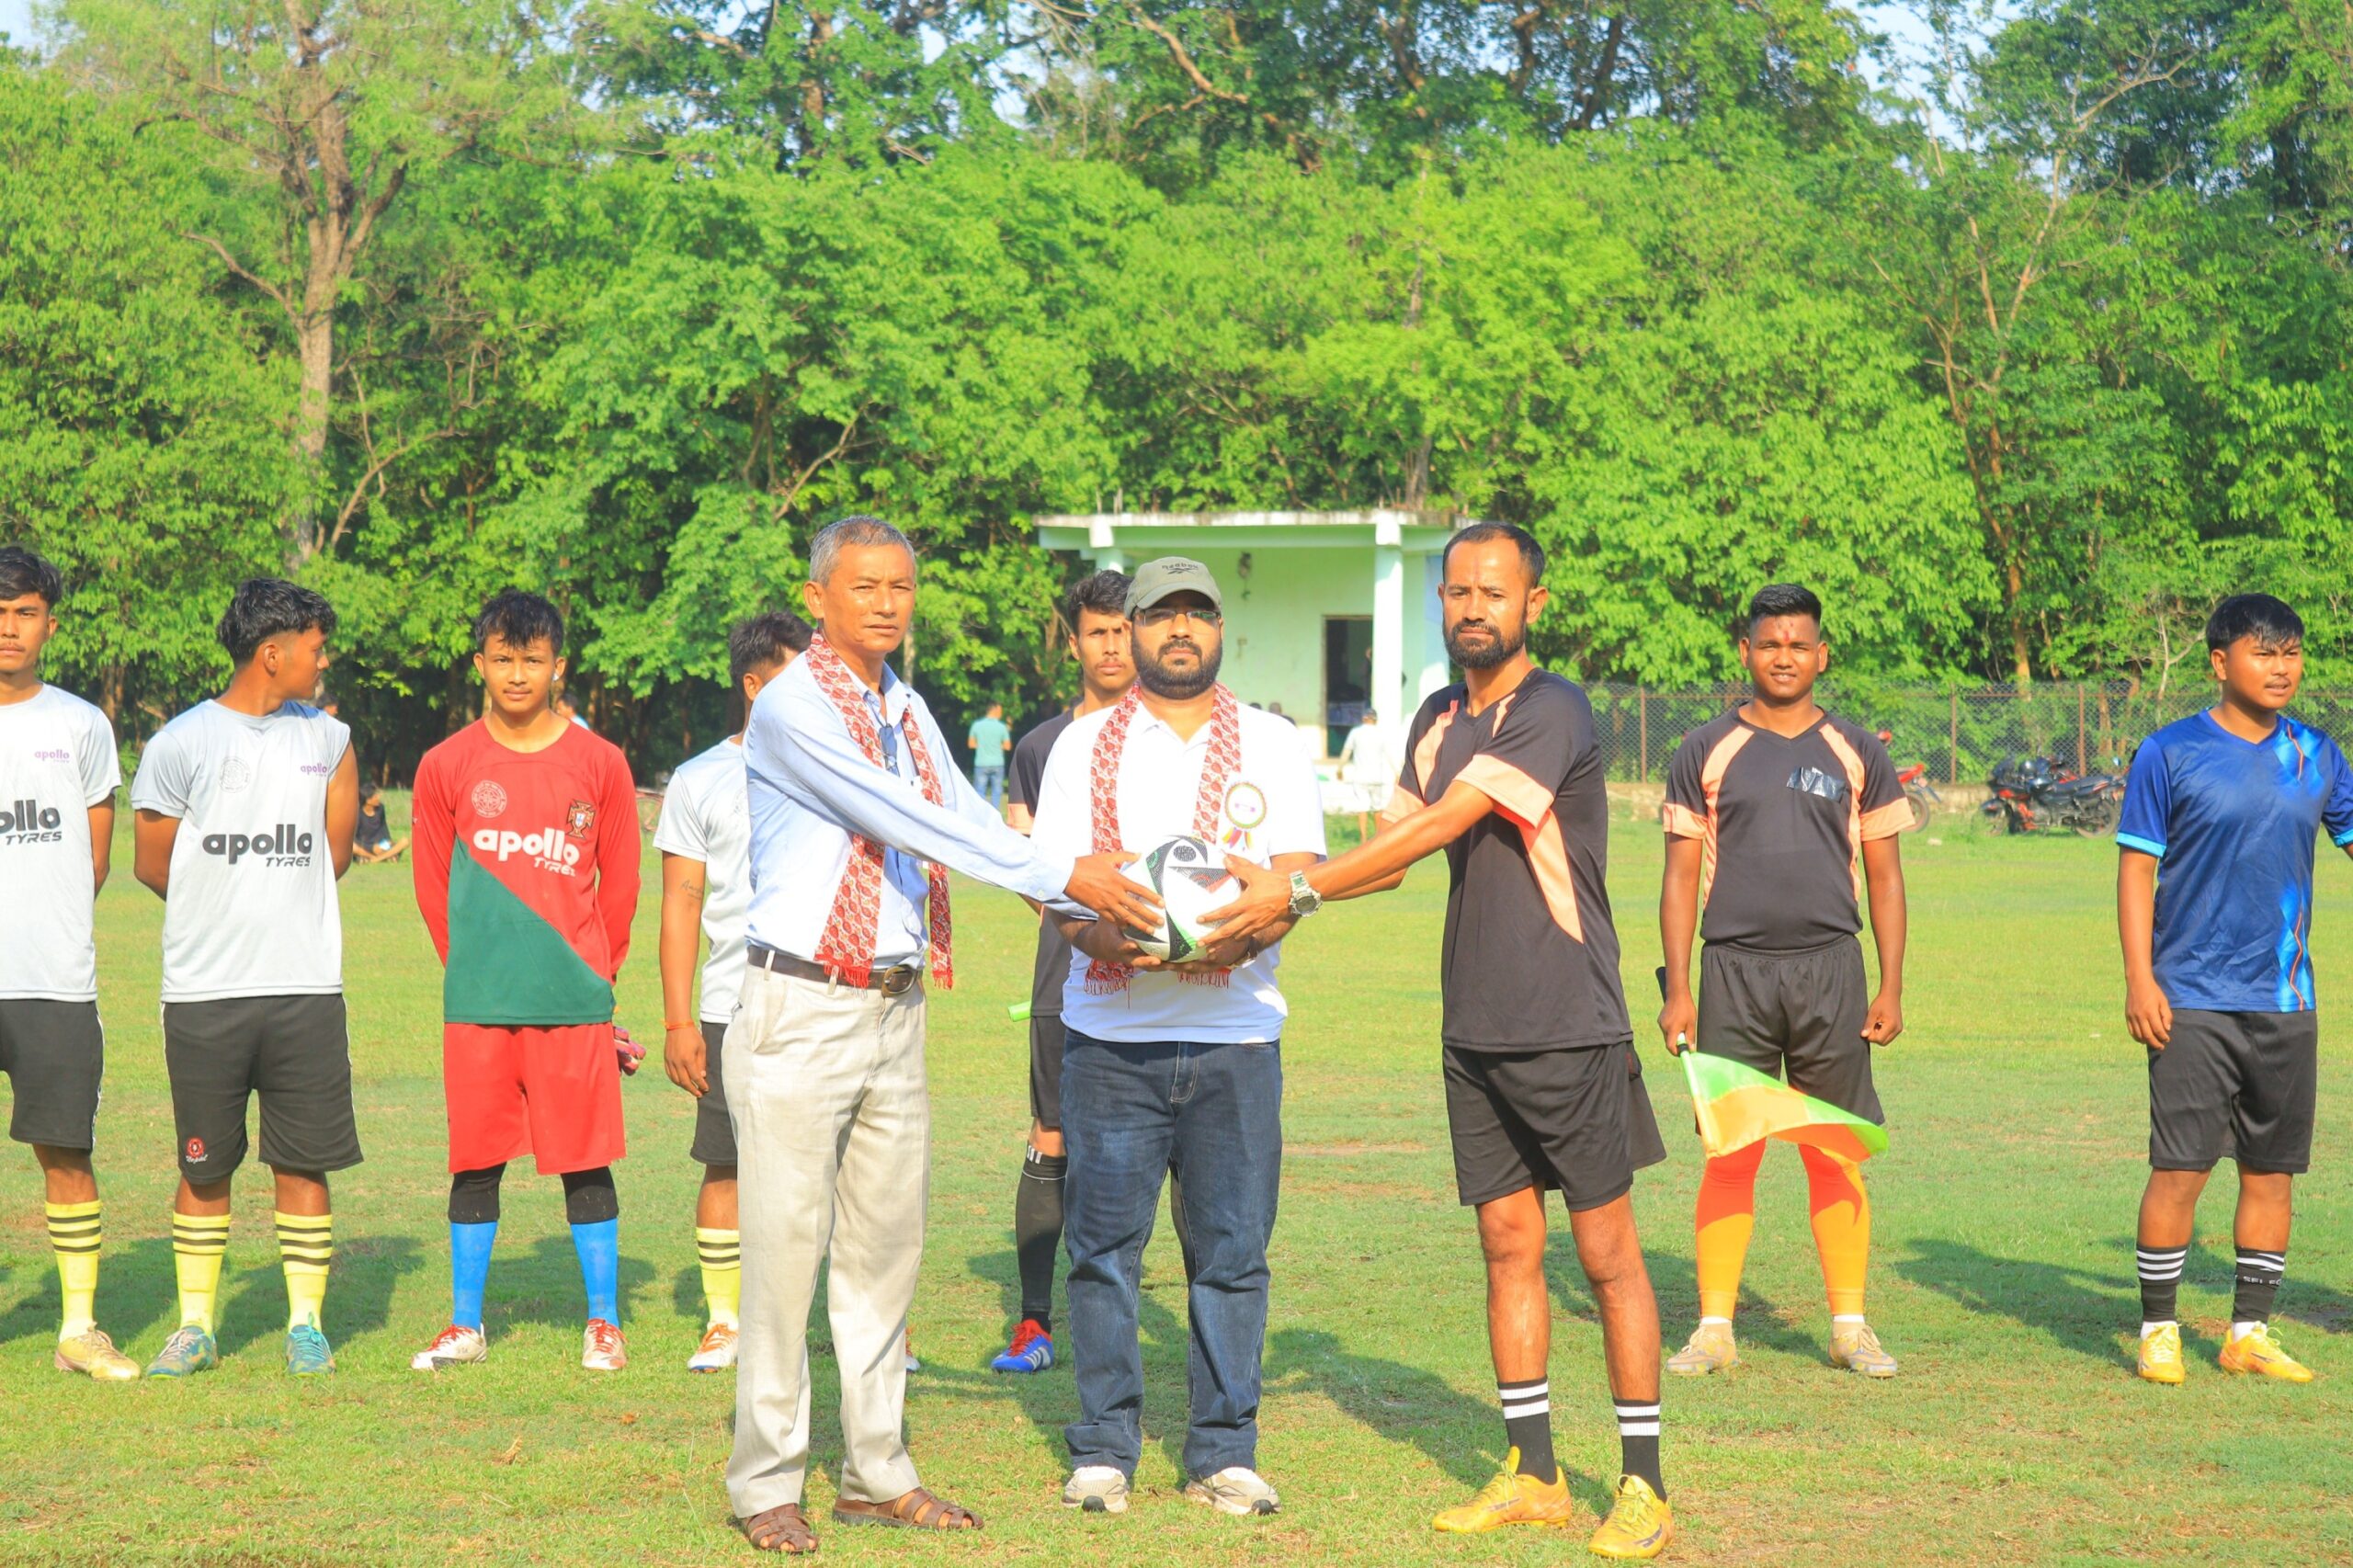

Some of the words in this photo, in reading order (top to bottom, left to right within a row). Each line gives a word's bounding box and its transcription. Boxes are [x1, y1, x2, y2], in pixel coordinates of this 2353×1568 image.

[34, 749, 70, 761] apollo
[300, 762, 327, 775] apollo
[6, 831, 63, 846] TYRES
[202, 824, 313, 865] apollo
[473, 827, 581, 866] apollo
[266, 857, 311, 868] TYRES
